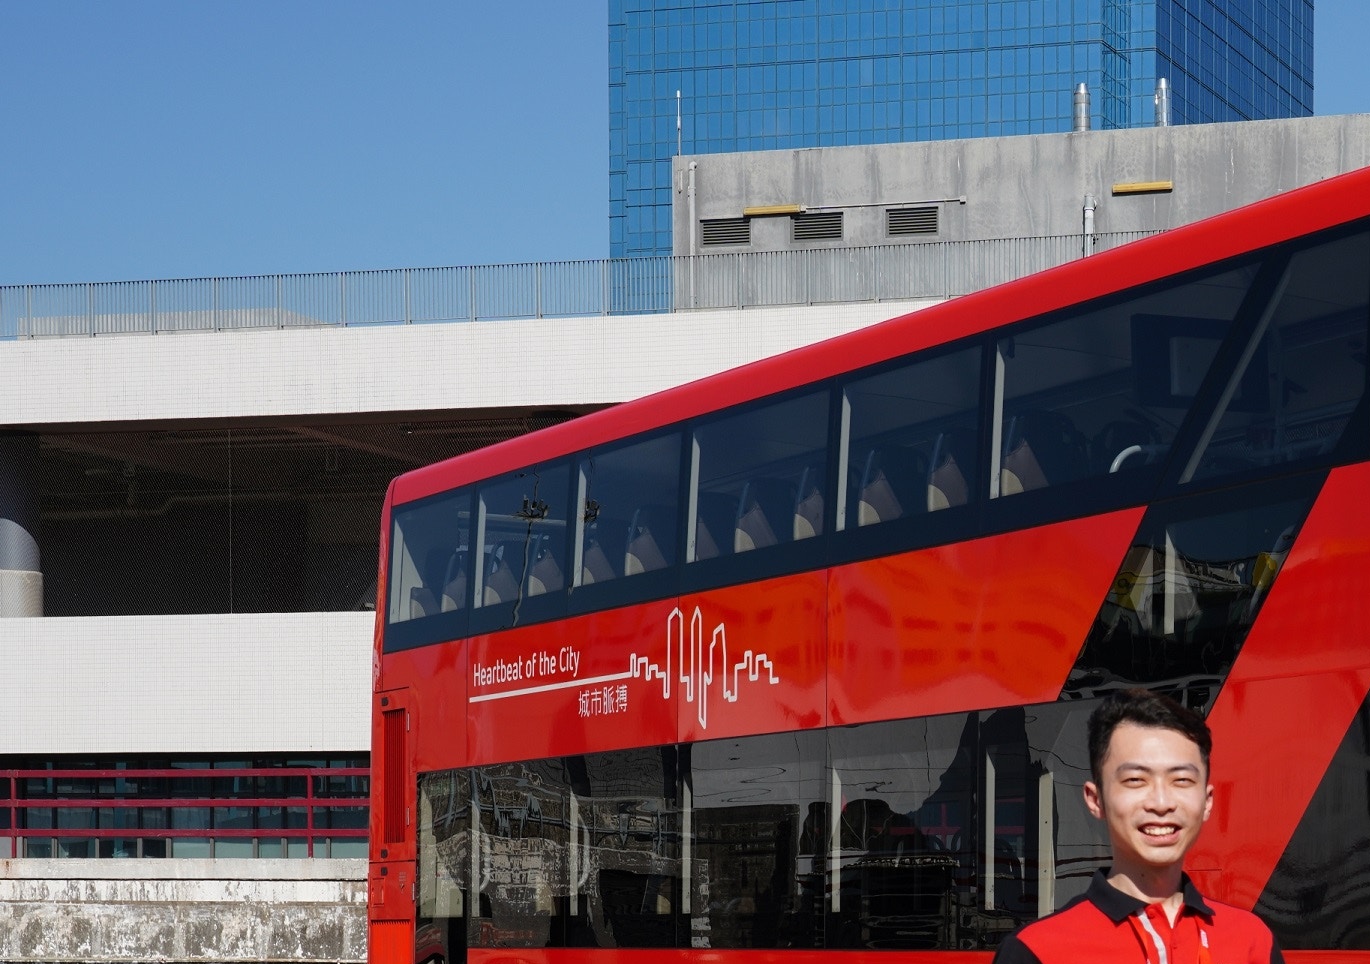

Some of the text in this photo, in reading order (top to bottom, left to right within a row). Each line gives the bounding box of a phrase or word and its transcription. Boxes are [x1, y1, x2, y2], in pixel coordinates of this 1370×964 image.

[473, 645, 580, 687] Heartbeat of the City
[578, 684, 628, 718] 城市脈搏
